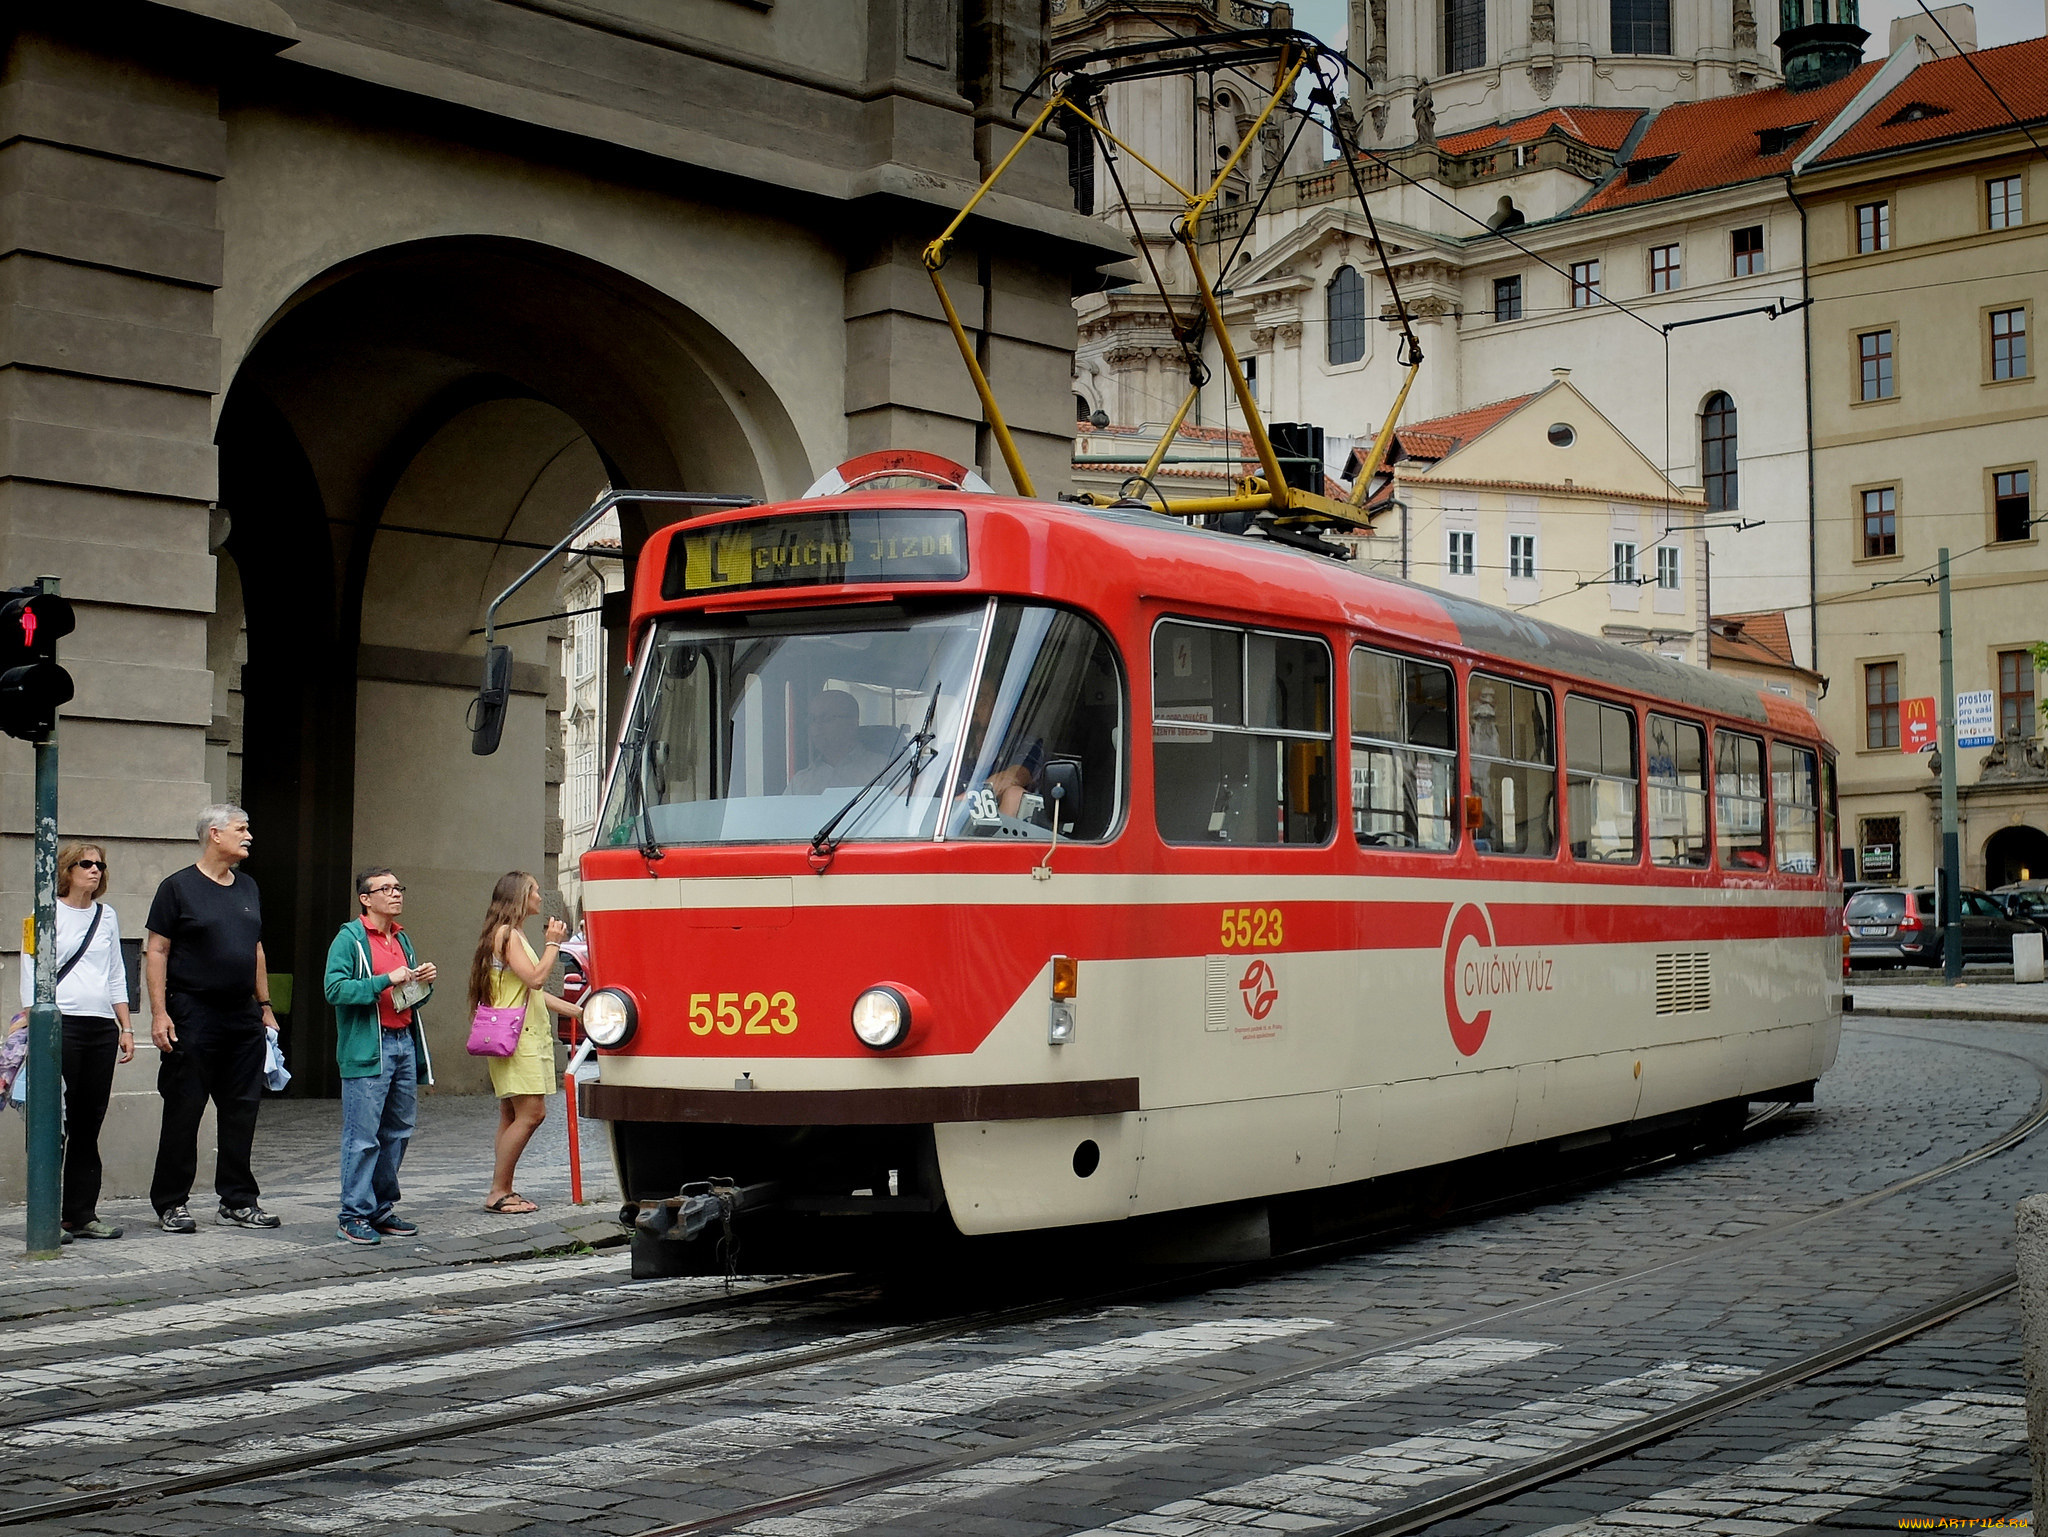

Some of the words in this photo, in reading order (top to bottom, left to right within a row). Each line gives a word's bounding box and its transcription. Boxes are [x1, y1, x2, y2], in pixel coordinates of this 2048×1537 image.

[870, 534, 953, 560] JÍZDA
[1958, 692, 1992, 708] prostor
[1958, 708, 1972, 717] pro
[1975, 705, 1992, 714] vaši
[1959, 716, 1992, 726] reklamu
[968, 789, 998, 819] 36
[1221, 908, 1283, 948] 5523
[1464, 953, 1521, 996] CVIČNÝ
[1525, 951, 1553, 992] VŮZ
[689, 991, 799, 1036] 5523
